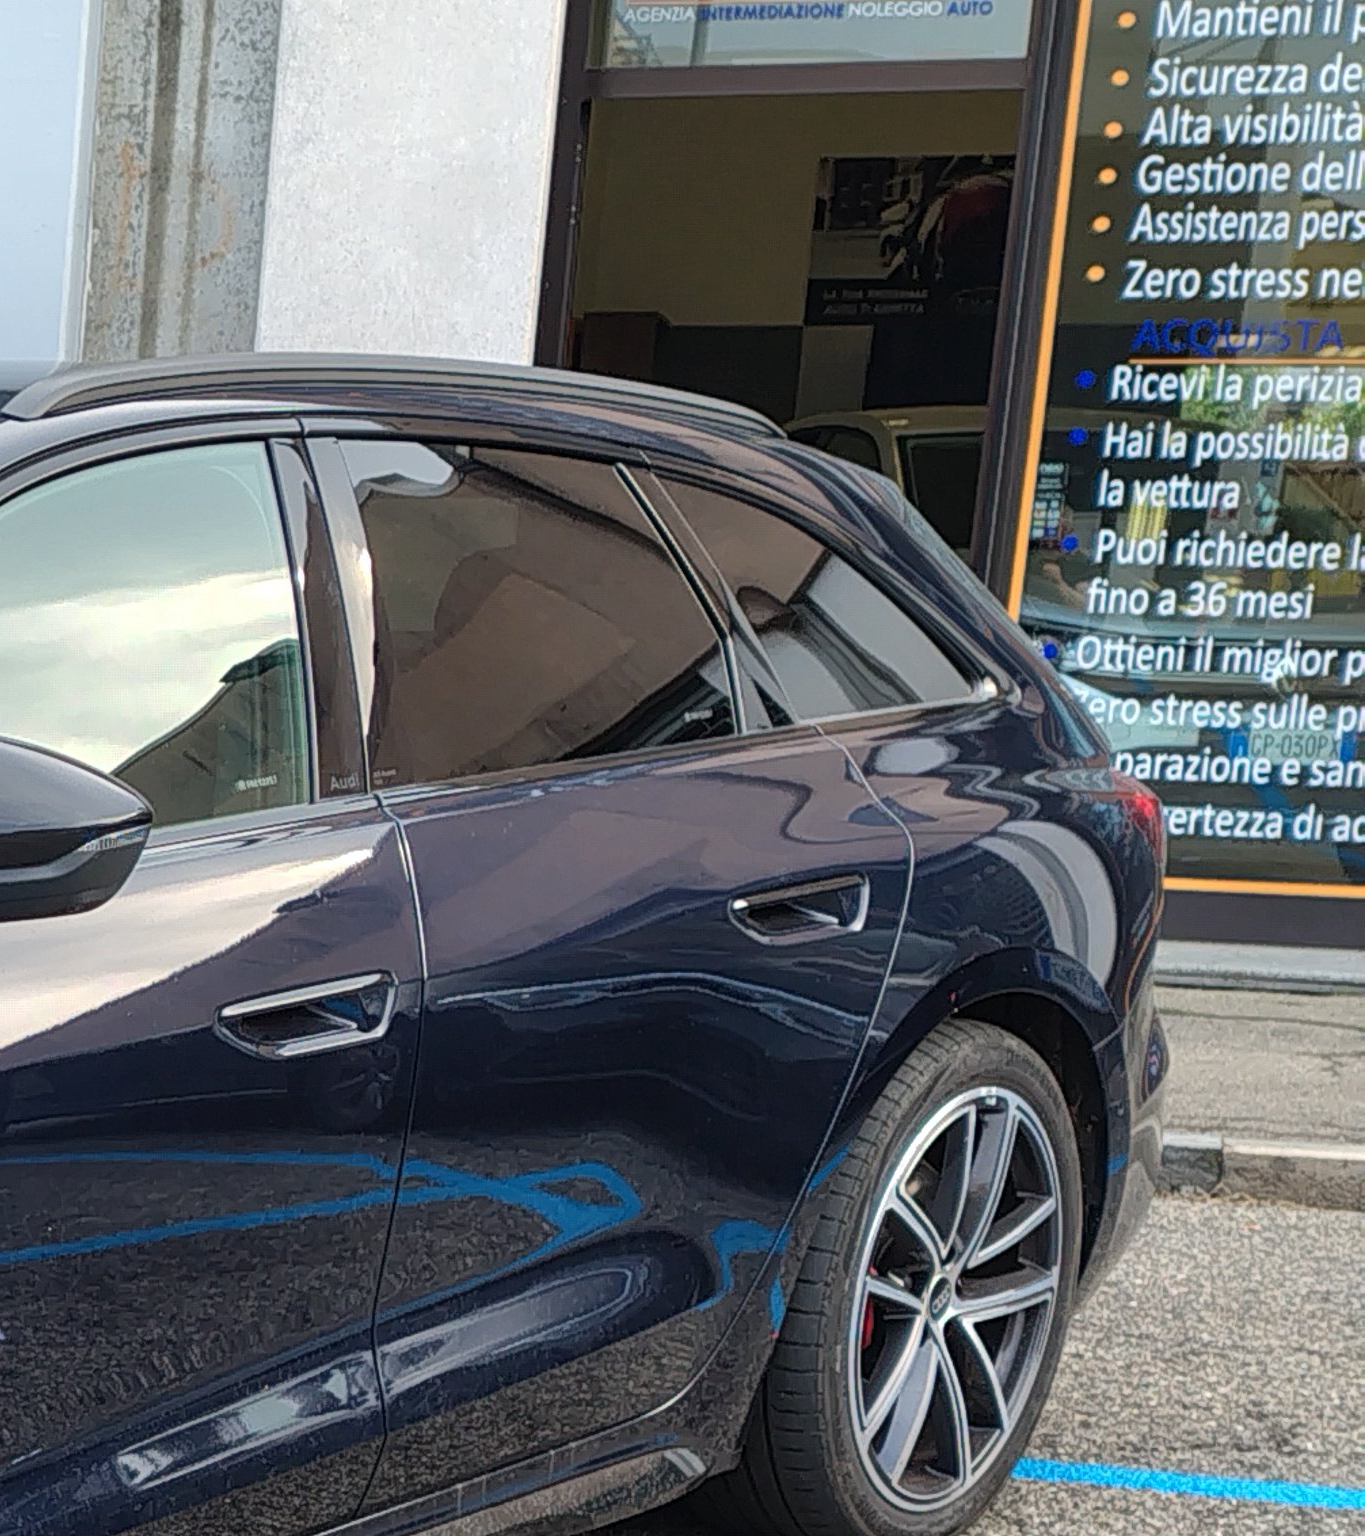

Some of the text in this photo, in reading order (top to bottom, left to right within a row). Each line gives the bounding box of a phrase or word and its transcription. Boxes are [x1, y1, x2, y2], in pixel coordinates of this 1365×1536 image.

[623, 0, 993, 23] AGENZIA INTERMEDIAZIONE NOLEGGIO AUTO
[1156, 0, 1313, 38] Mantieni
[1322, 0, 1344, 35] il
[1148, 56, 1309, 97] Sicurezza
[1140, 100, 1364, 146] Alta visibilità
[1136, 152, 1291, 194] Gestione
[1128, 201, 1291, 243] Assistenza
[1121, 259, 1201, 300] Zero
[1209, 261, 1311, 300] stress
[1130, 317, 1345, 357] ACQUISTA
[1109, 362, 1363, 411] Ricevi la perizia
[1101, 420, 1155, 459] Hai
[1159, 419, 1188, 460] la
[1191, 421, 1350, 470] possibilità
[1096, 467, 1125, 508] la
[1131, 472, 1242, 510] vettura
[1092, 528, 1169, 566] Puoi
[1171, 528, 1342, 571] richiedere
[1085, 576, 1317, 621] fino a 36 mesi
[1075, 634, 1187, 674] Ottieni
[1192, 634, 1215, 674] il
[1220, 637, 1339, 684] miglior
[1149, 693, 1244, 728] stress
[1251, 692, 1328, 732] sulle
[329, 772, 361, 791] Audi
[1114, 746, 1272, 785] parazione
[1281, 758, 1302, 786] e
[1162, 802, 1284, 840] ertezza
[1293, 802, 1325, 843] di
